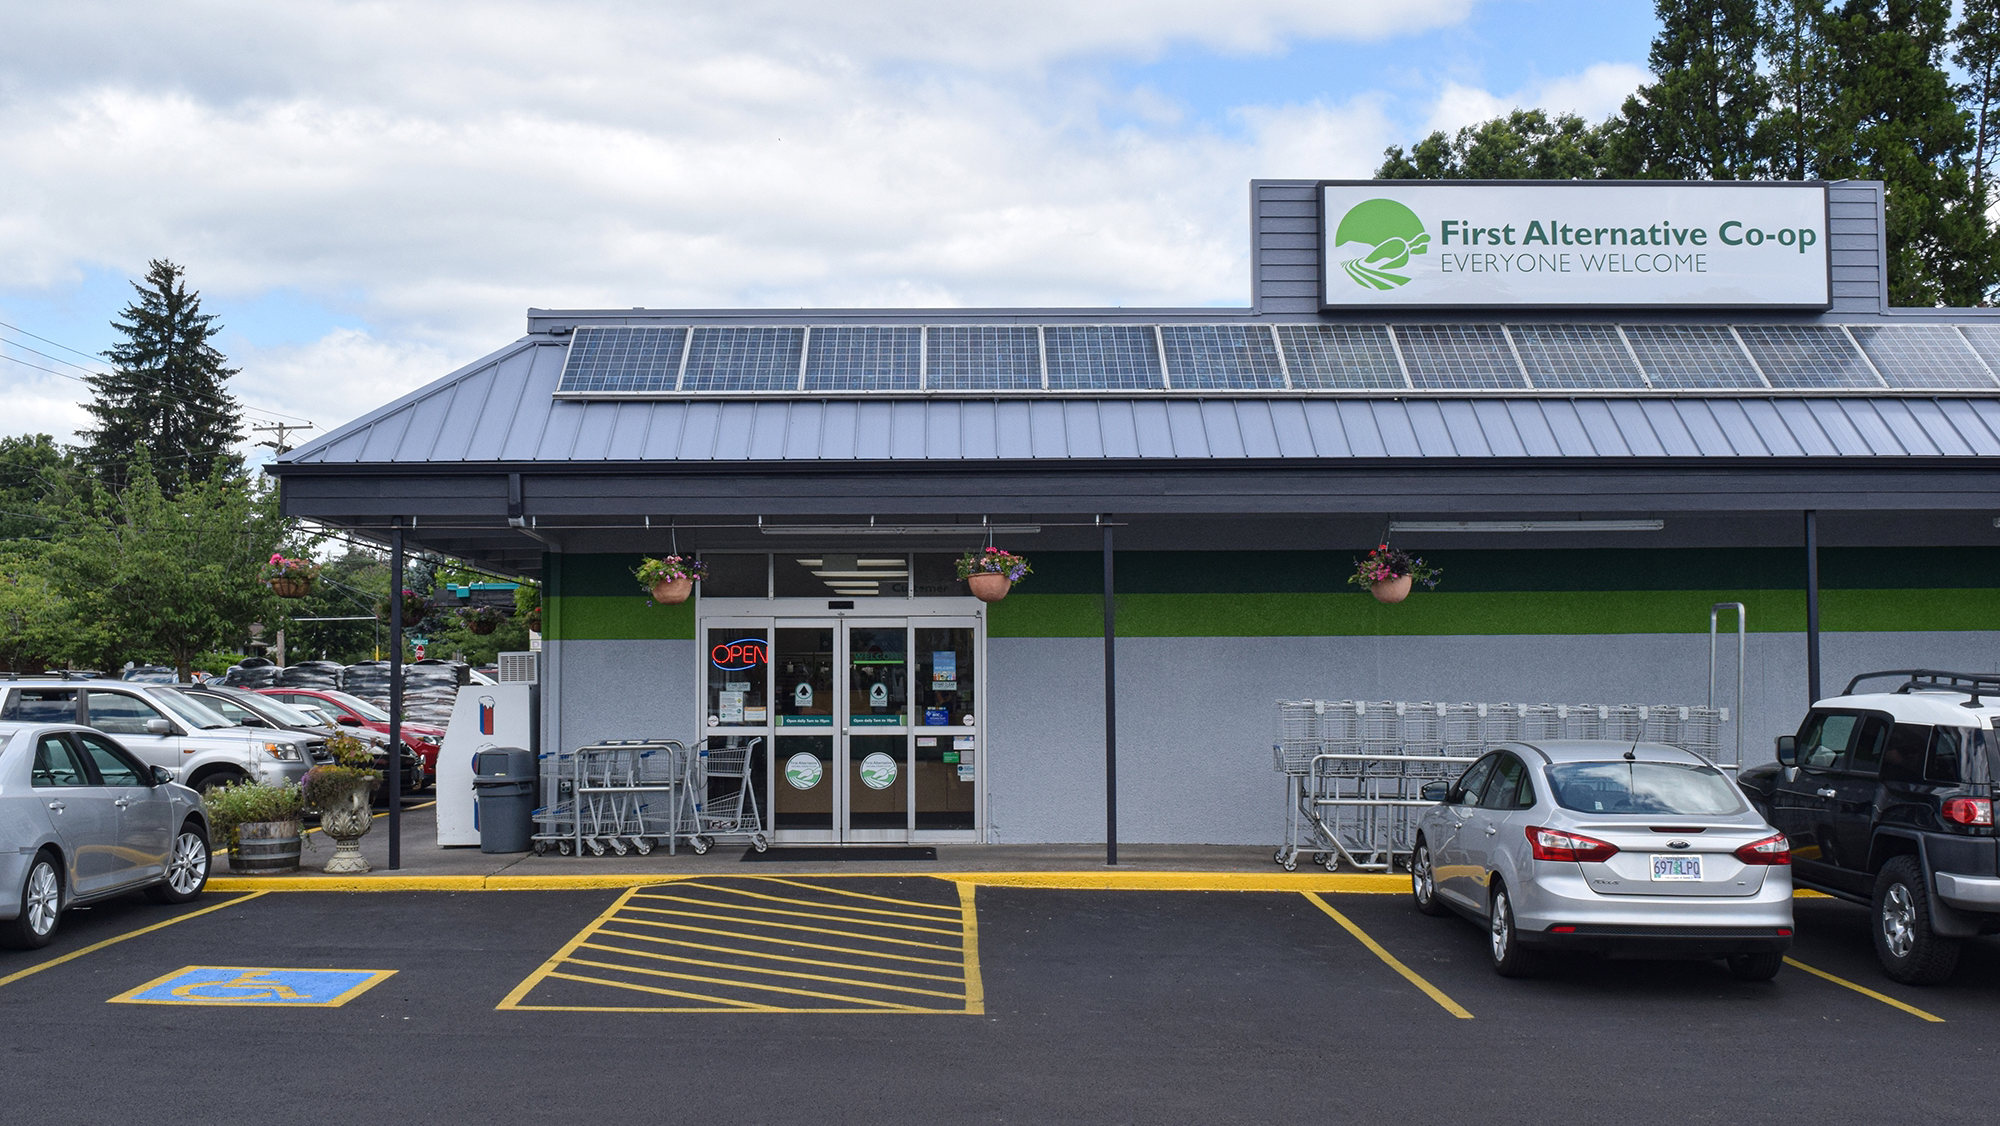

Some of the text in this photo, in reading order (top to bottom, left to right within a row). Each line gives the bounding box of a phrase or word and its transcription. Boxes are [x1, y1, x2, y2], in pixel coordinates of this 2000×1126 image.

[1441, 220, 1817, 254] First Alternative Co-op
[1441, 253, 1707, 273] EVERYONE WELCOME
[891, 583, 949, 593] Cutomer
[712, 645, 768, 664] OPEN
[1654, 861, 1700, 875] 697 LPQ
